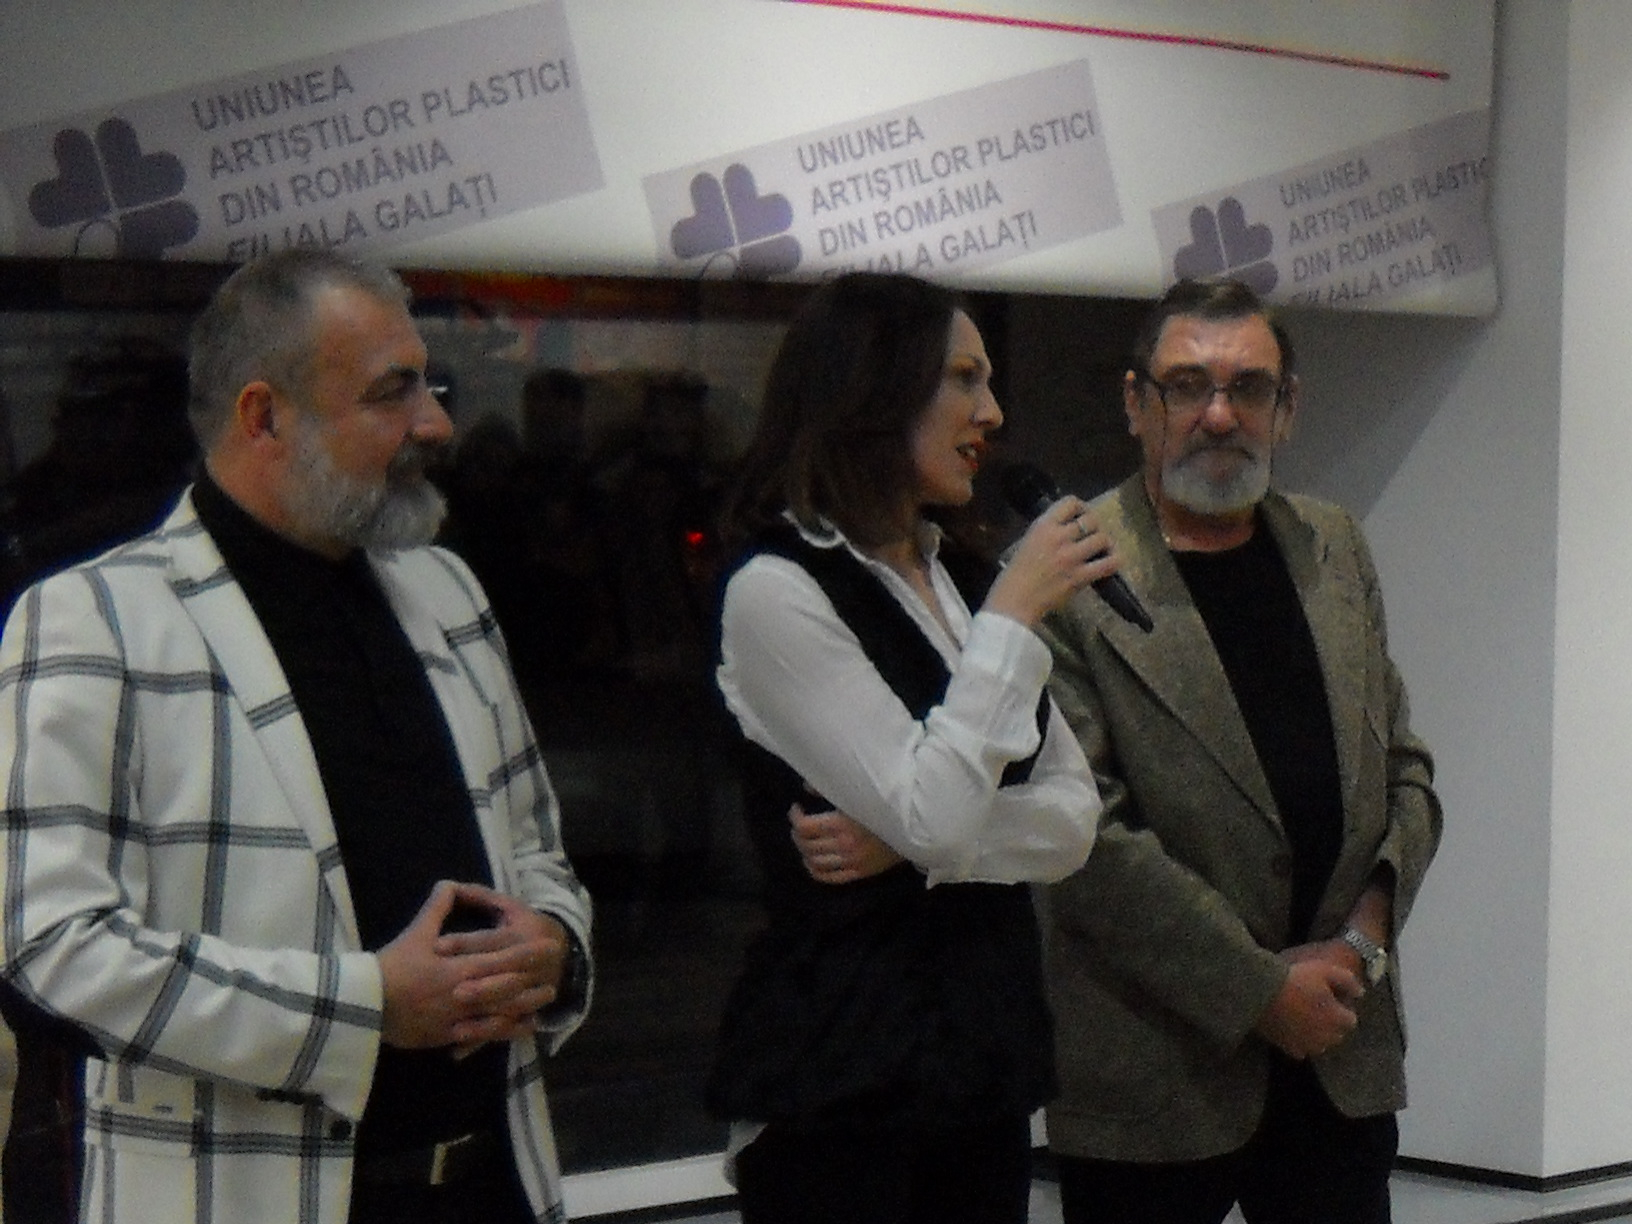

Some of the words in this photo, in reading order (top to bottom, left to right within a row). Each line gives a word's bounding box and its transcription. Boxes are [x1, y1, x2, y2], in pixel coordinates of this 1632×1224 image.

[191, 64, 355, 131] UNIUNEA
[421, 59, 570, 123] PLASTICI
[797, 115, 925, 174] UNIUNEA
[976, 109, 1095, 168] PLASTICI
[218, 182, 281, 228] DIN
[290, 138, 453, 206] ROMÂNIA
[818, 217, 868, 257] DIN
[873, 179, 1003, 240] ROMÂNIA
[1293, 249, 1331, 283] DIN
